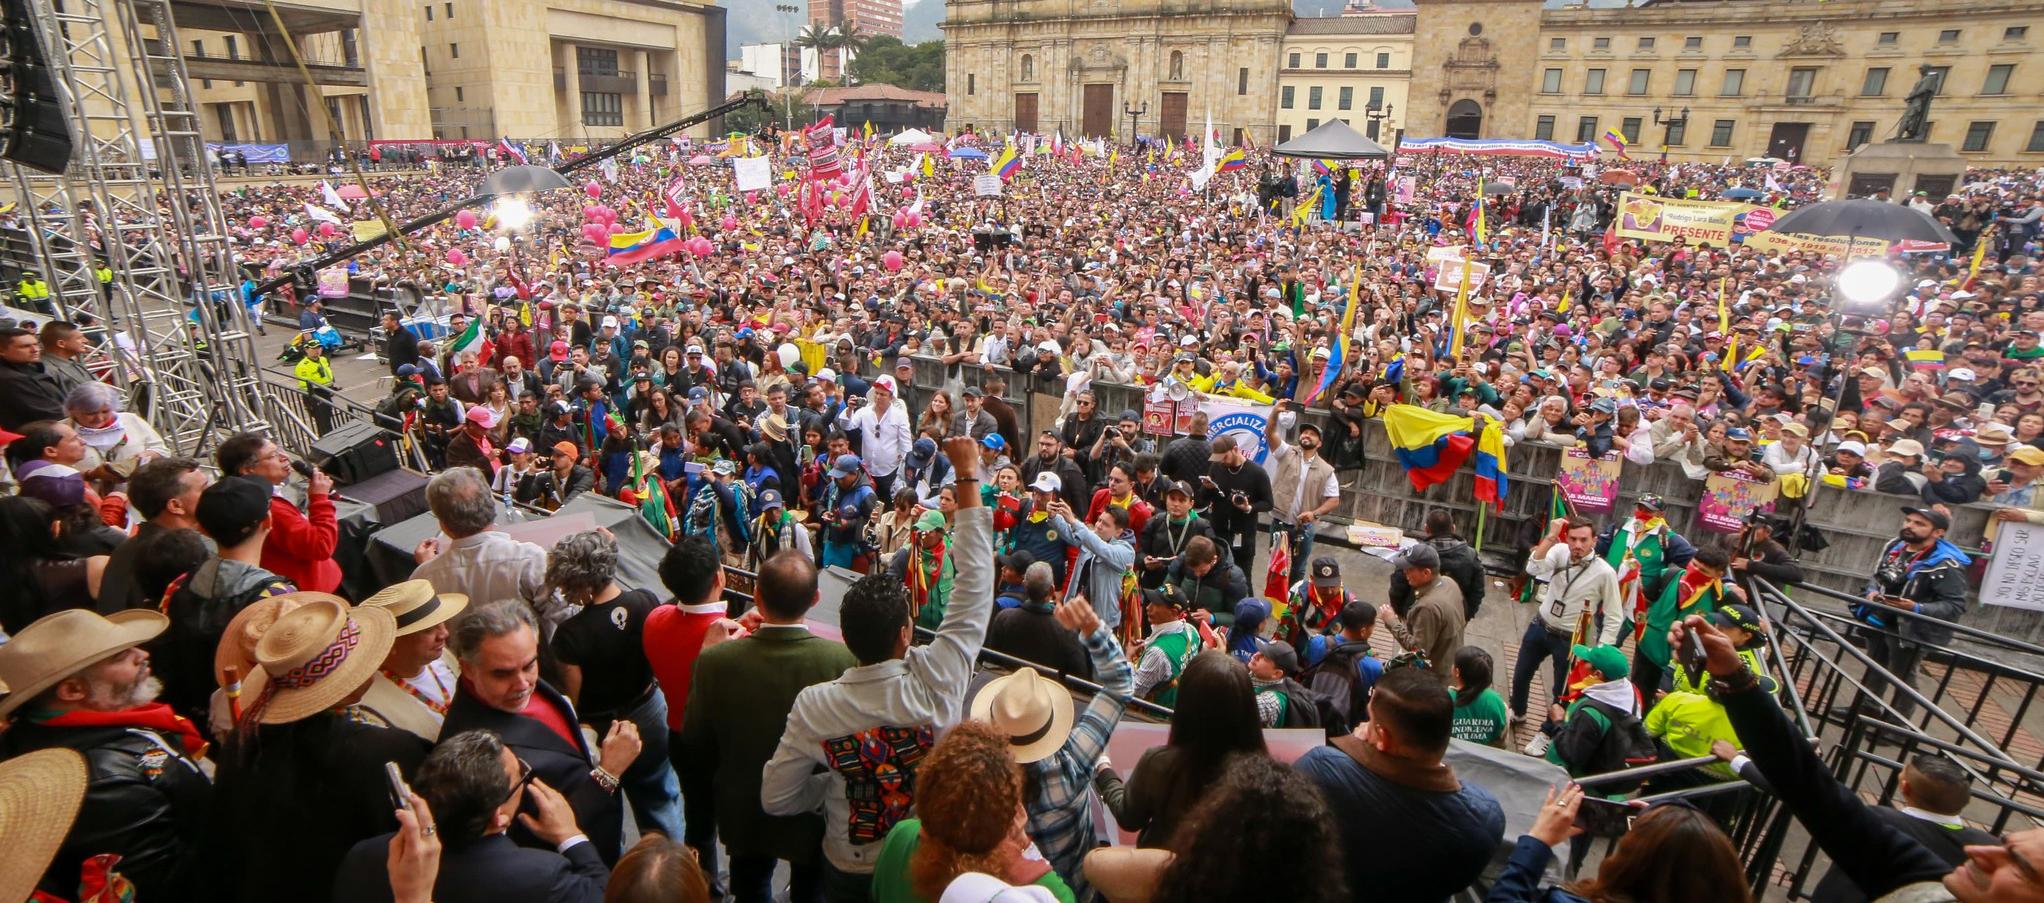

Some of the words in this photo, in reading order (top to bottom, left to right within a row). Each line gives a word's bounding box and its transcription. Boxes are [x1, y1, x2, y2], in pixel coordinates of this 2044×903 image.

[1662, 224, 1726, 241] PRESENTE
[1813, 236, 1882, 247] resoluciones
[1577, 494, 1609, 503] MARZO
[2000, 572, 2017, 584] NO
[1996, 587, 2012, 598] YO
[1452, 718, 1494, 727] GUARDIA
